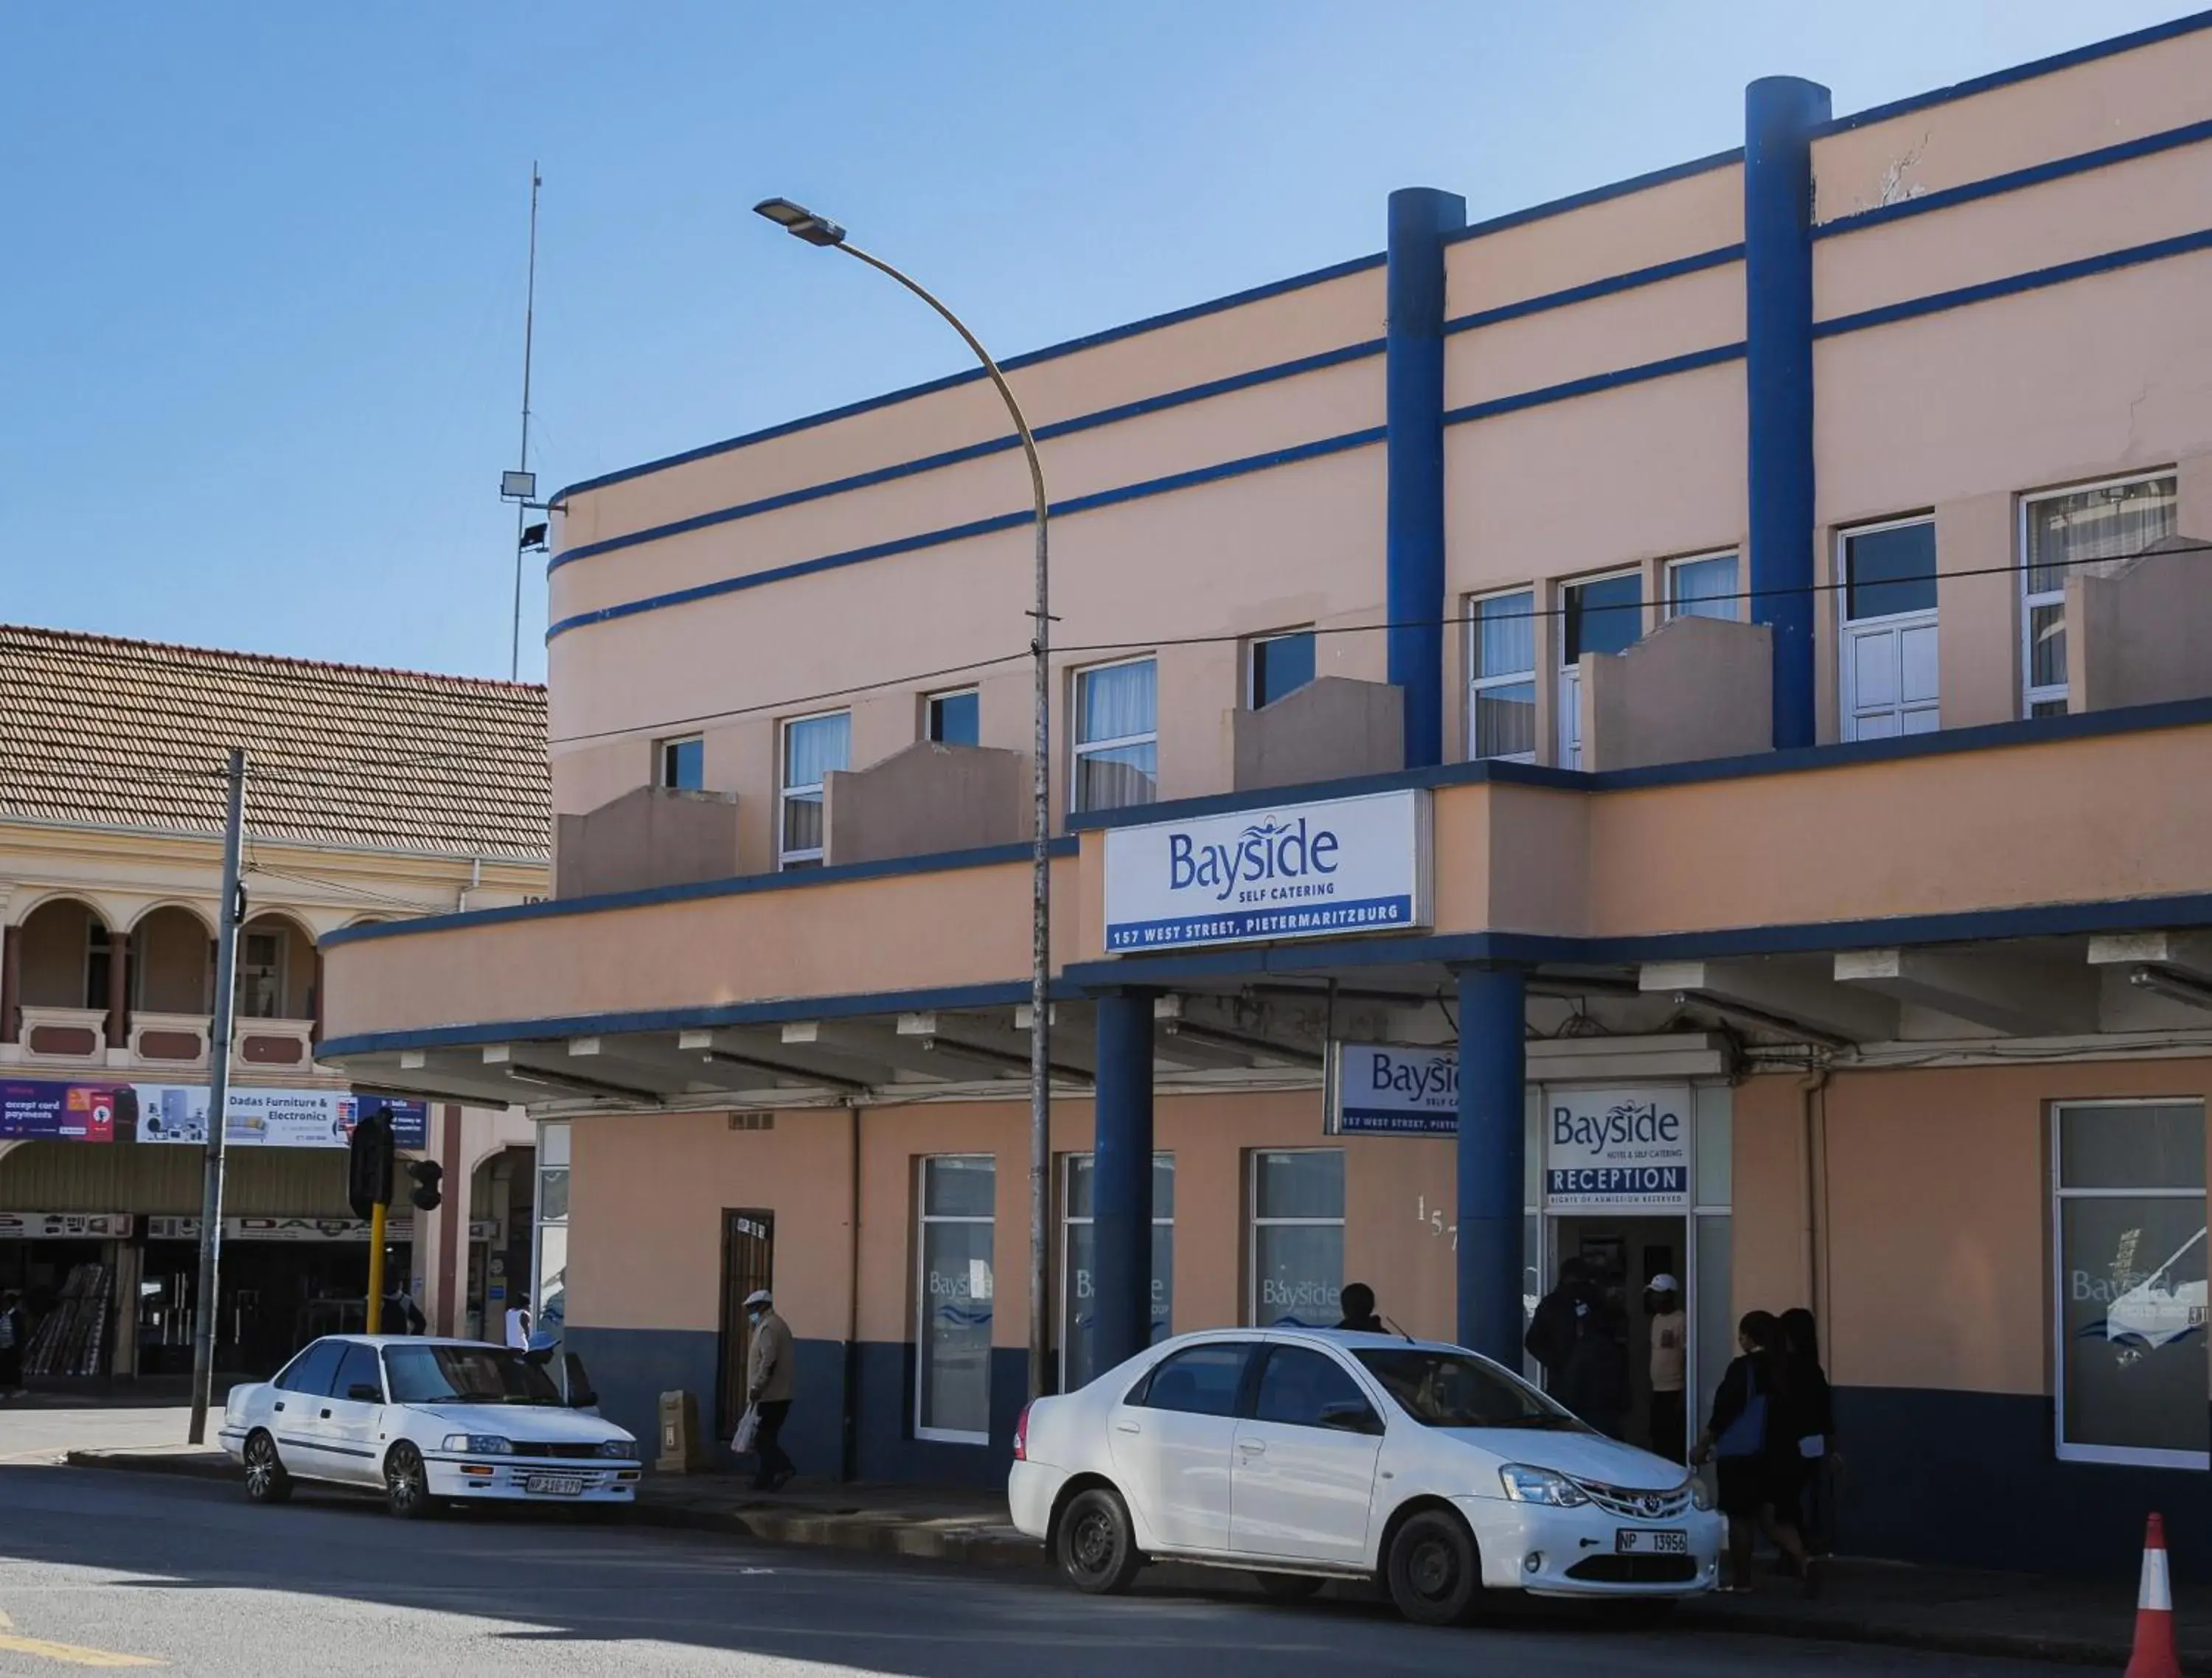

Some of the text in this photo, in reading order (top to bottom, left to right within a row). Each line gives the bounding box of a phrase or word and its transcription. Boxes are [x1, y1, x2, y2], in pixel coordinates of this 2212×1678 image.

[1169, 818, 1338, 900] Bayside
[1239, 883, 1334, 903] SELF CATERING
[1113, 904, 1398, 944] 157 WEST STREET, PIETERMARITZBURG
[5, 1101, 60, 1110] accept card
[229, 1096, 327, 1107] Dadas Furniture &
[4, 1110, 53, 1119] payments
[268, 1111, 328, 1121] Electronics
[1554, 1103, 1680, 1155] Bayside
[1554, 1168, 1677, 1190] RECEPTION
[1263, 1278, 1340, 1312] Bayside
[1620, 1533, 1686, 1552] NP 13956
